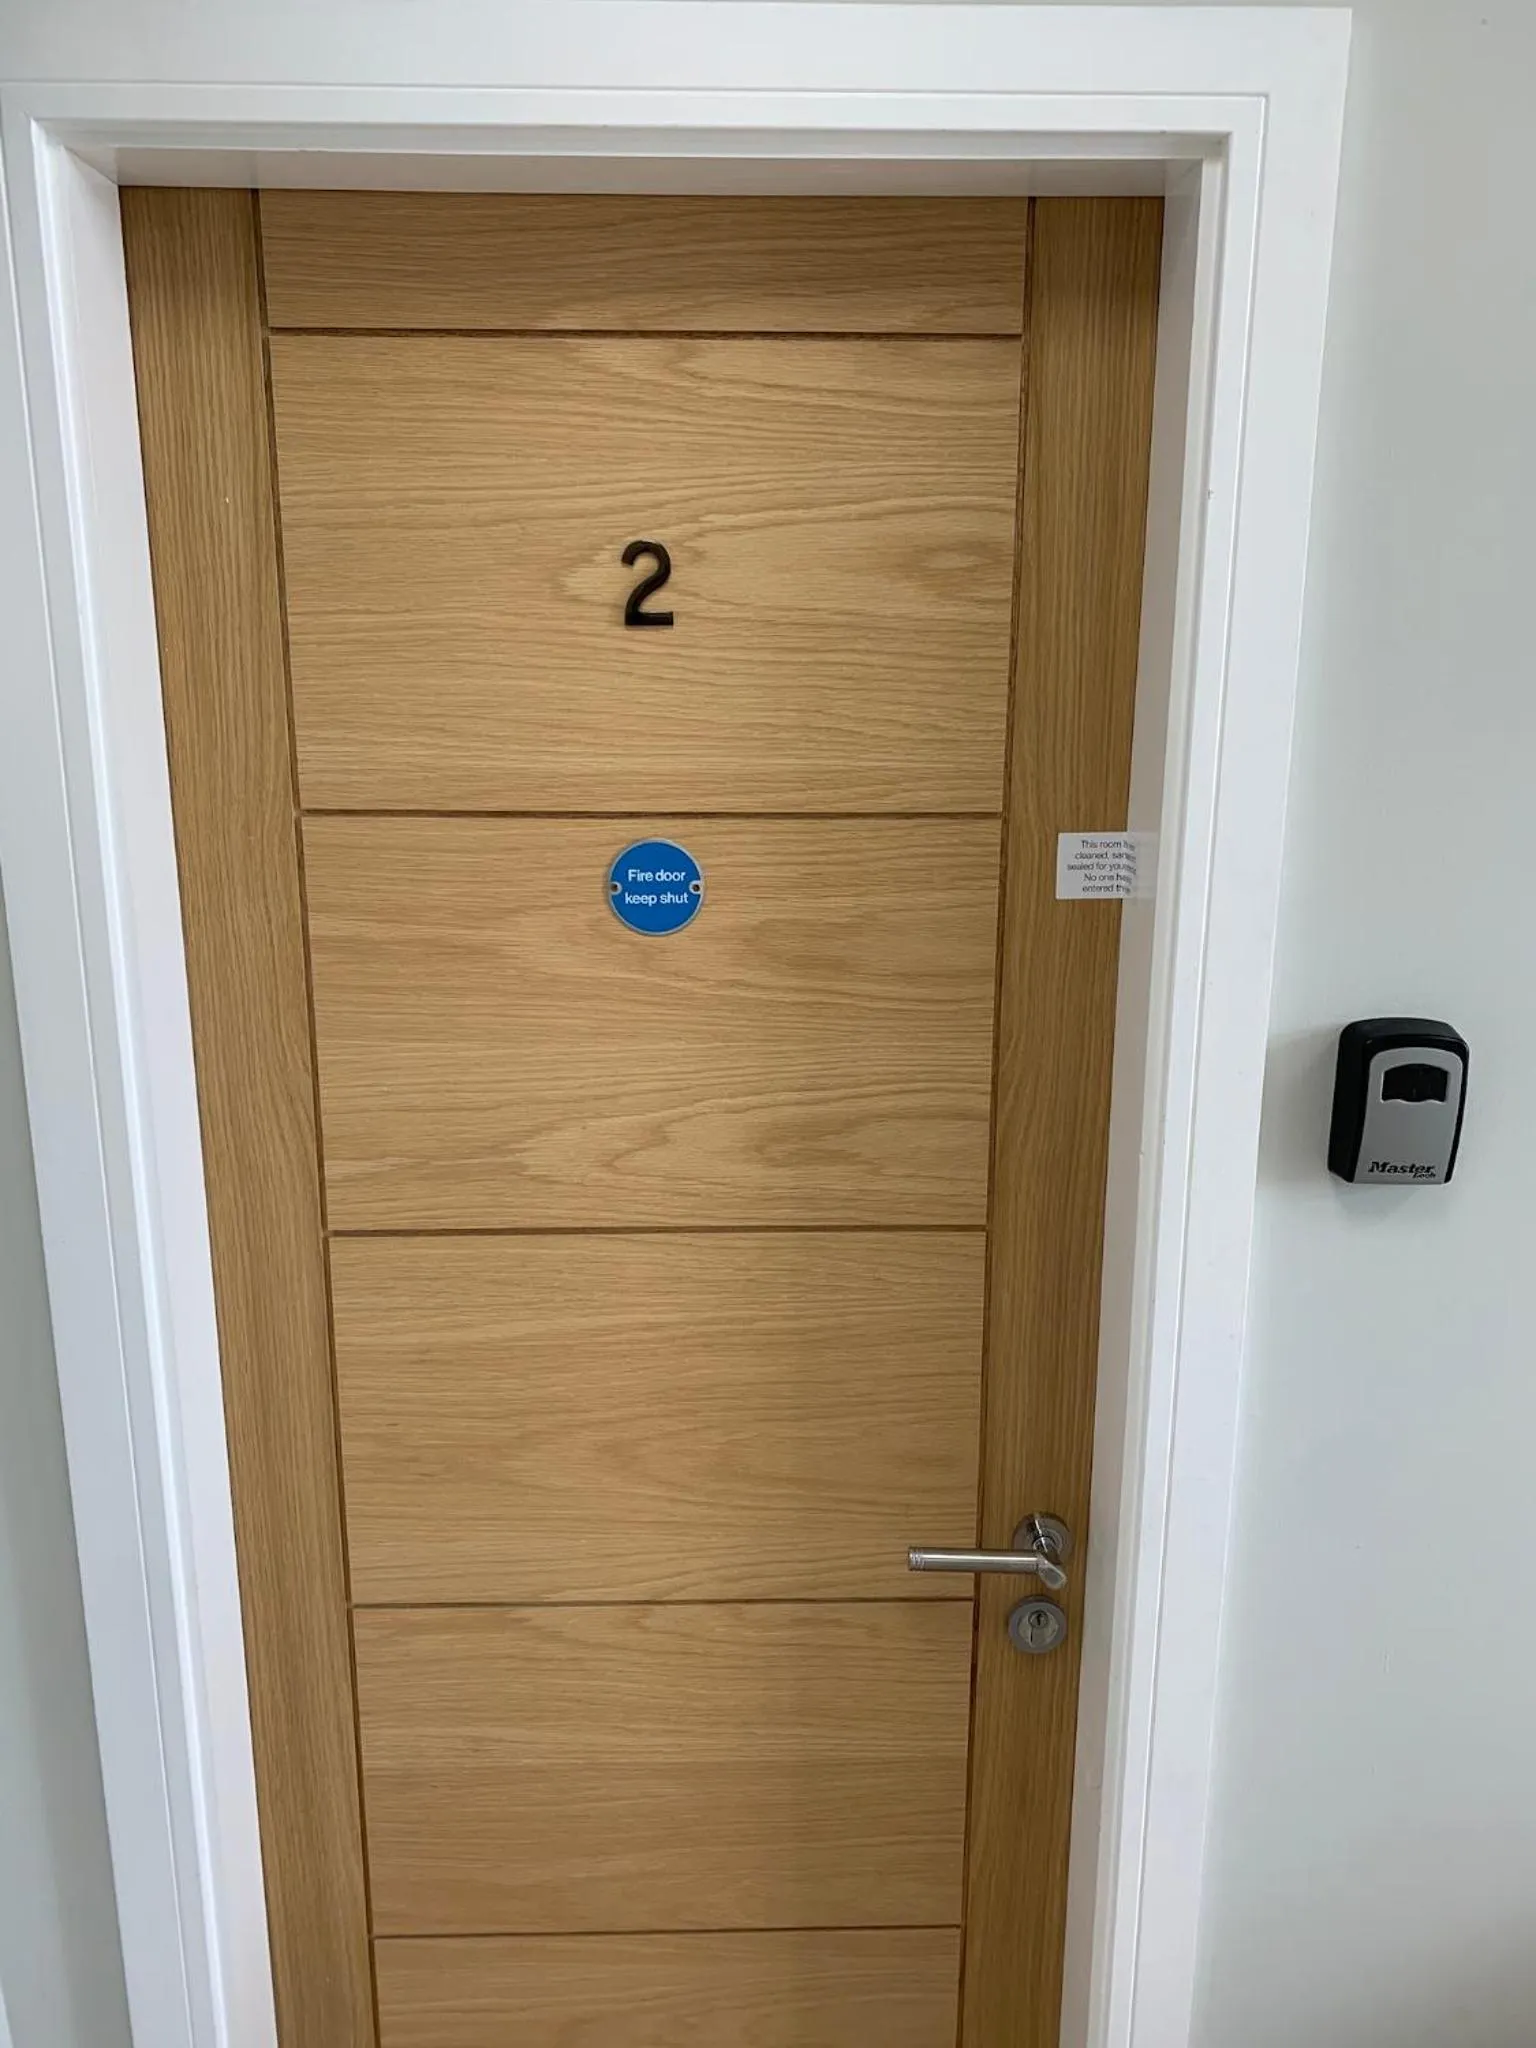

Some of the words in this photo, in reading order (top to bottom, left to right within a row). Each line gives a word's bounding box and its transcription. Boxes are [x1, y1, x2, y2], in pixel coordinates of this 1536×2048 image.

[621, 540, 674, 626] 2
[1081, 840, 1098, 849] This
[1099, 840, 1122, 849] room
[1096, 862, 1107, 871] for
[627, 869, 654, 882] Fire
[655, 869, 687, 882] door
[1084, 873, 1097, 881] No
[1082, 884, 1114, 892] entered
[624, 891, 657, 907] keep
[659, 891, 689, 904] shut
[1368, 1161, 1436, 1174] Master
